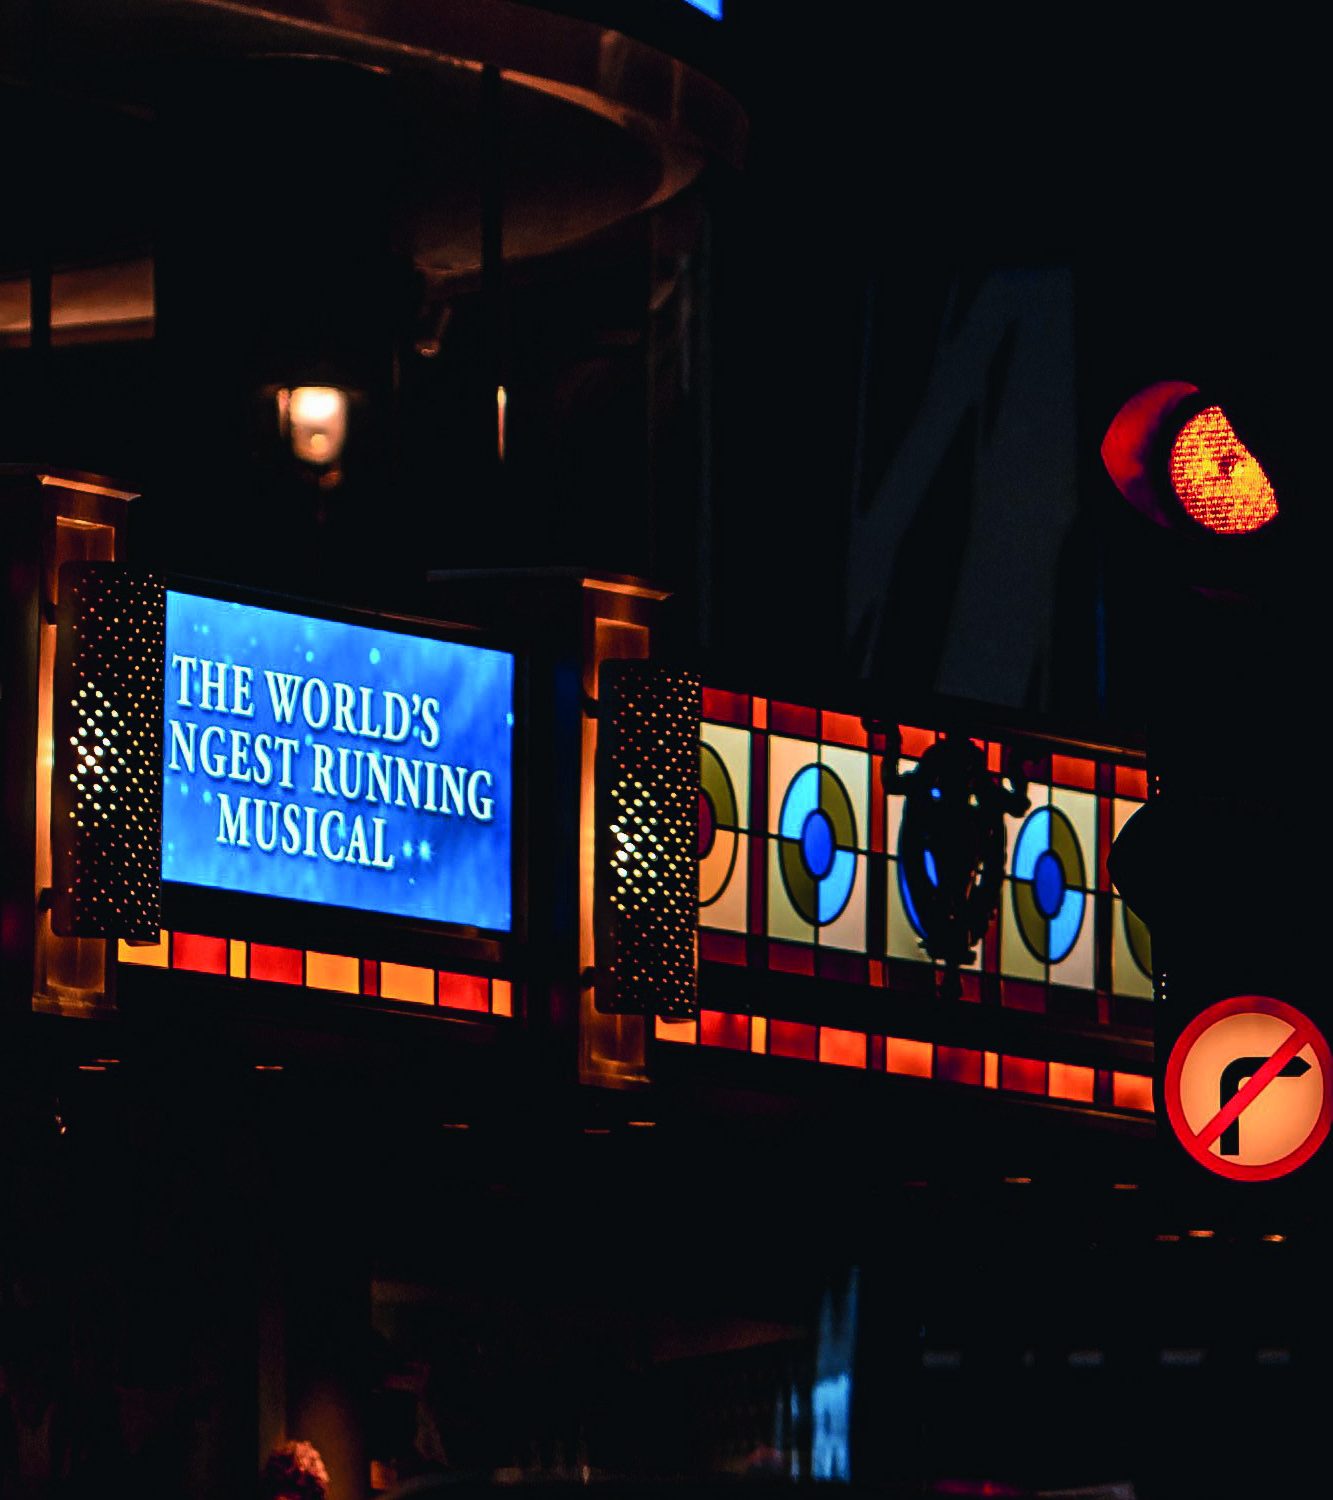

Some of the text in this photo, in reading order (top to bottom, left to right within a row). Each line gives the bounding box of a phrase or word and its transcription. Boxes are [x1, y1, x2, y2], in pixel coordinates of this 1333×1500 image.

[171, 653, 440, 748] THE WORLD'S
[168, 719, 494, 821] NGEST RUNNING
[217, 793, 395, 870] MUSICAL
